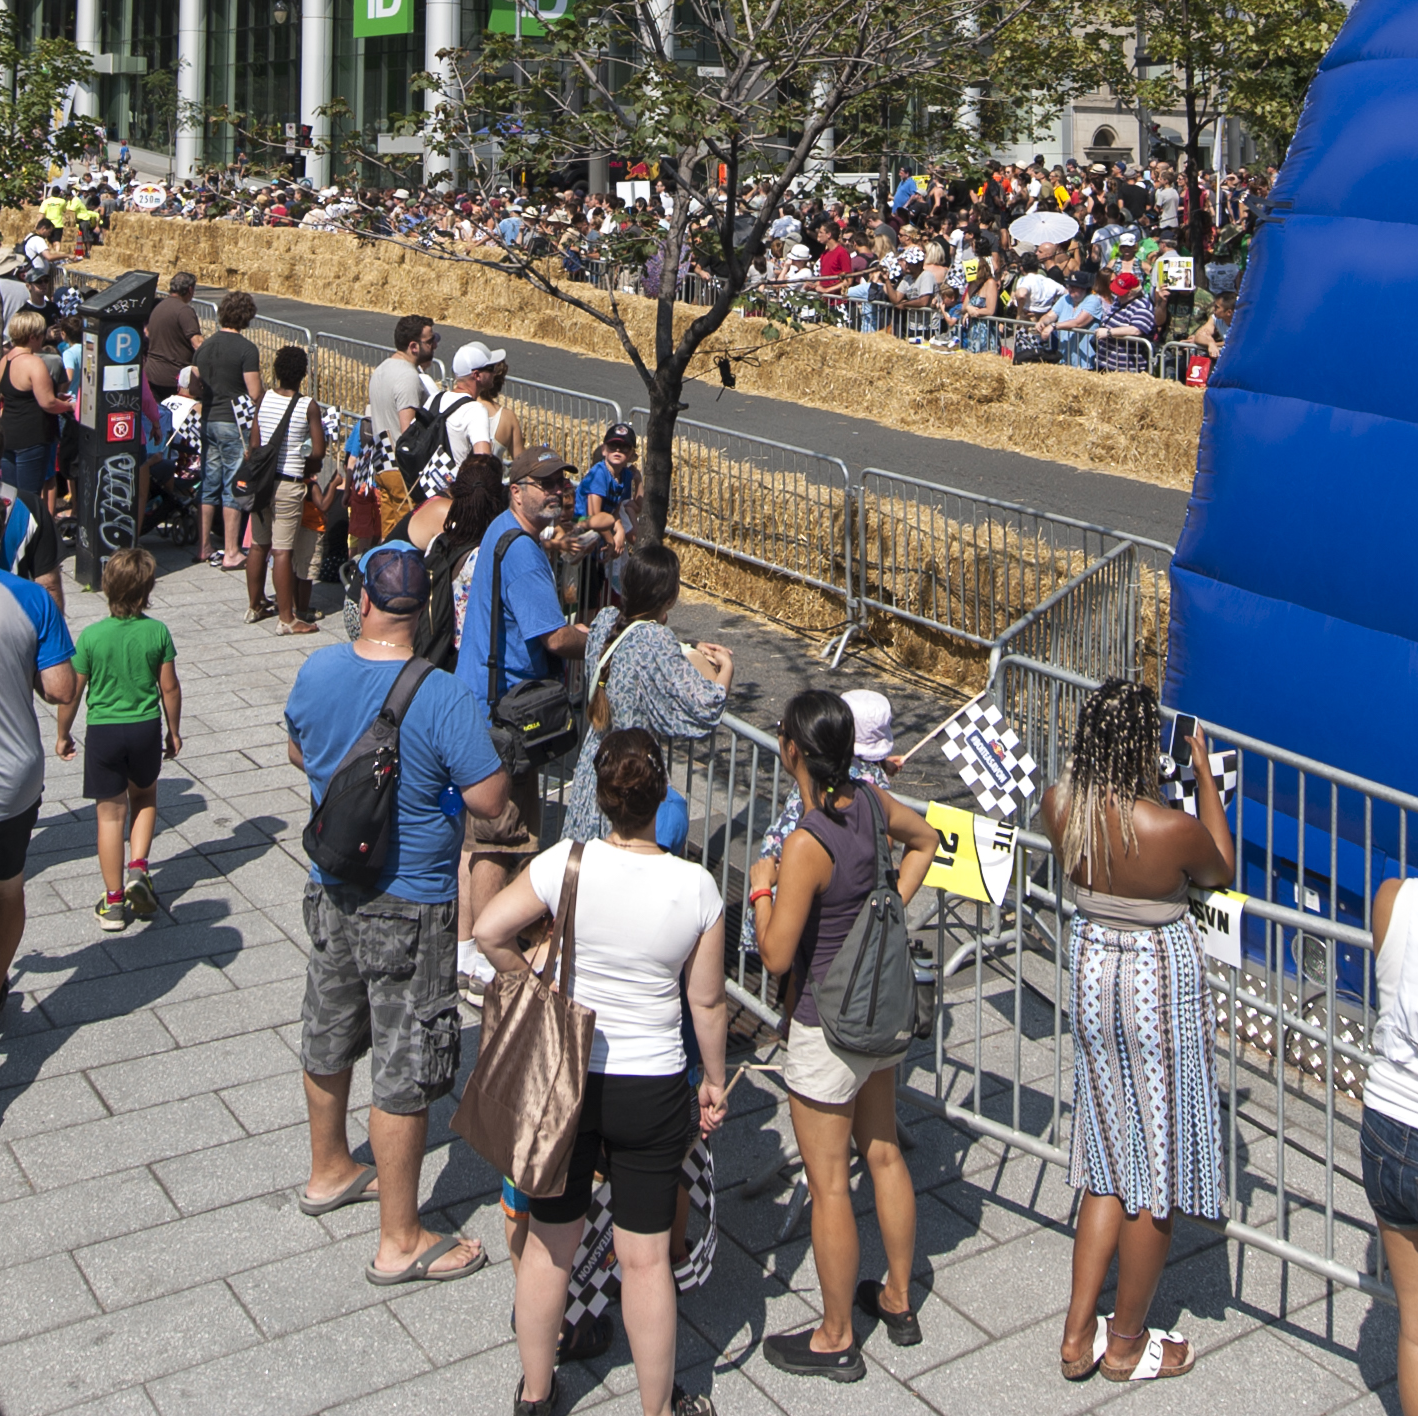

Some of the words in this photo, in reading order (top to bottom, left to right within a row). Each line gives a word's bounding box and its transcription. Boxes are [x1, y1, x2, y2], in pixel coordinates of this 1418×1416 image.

[139, 195, 160, 204] 250m
[970, 735, 1008, 784] #BOITEASAVON
[932, 828, 959, 868] 21
[577, 1225, 614, 1282] OITEASAVON
